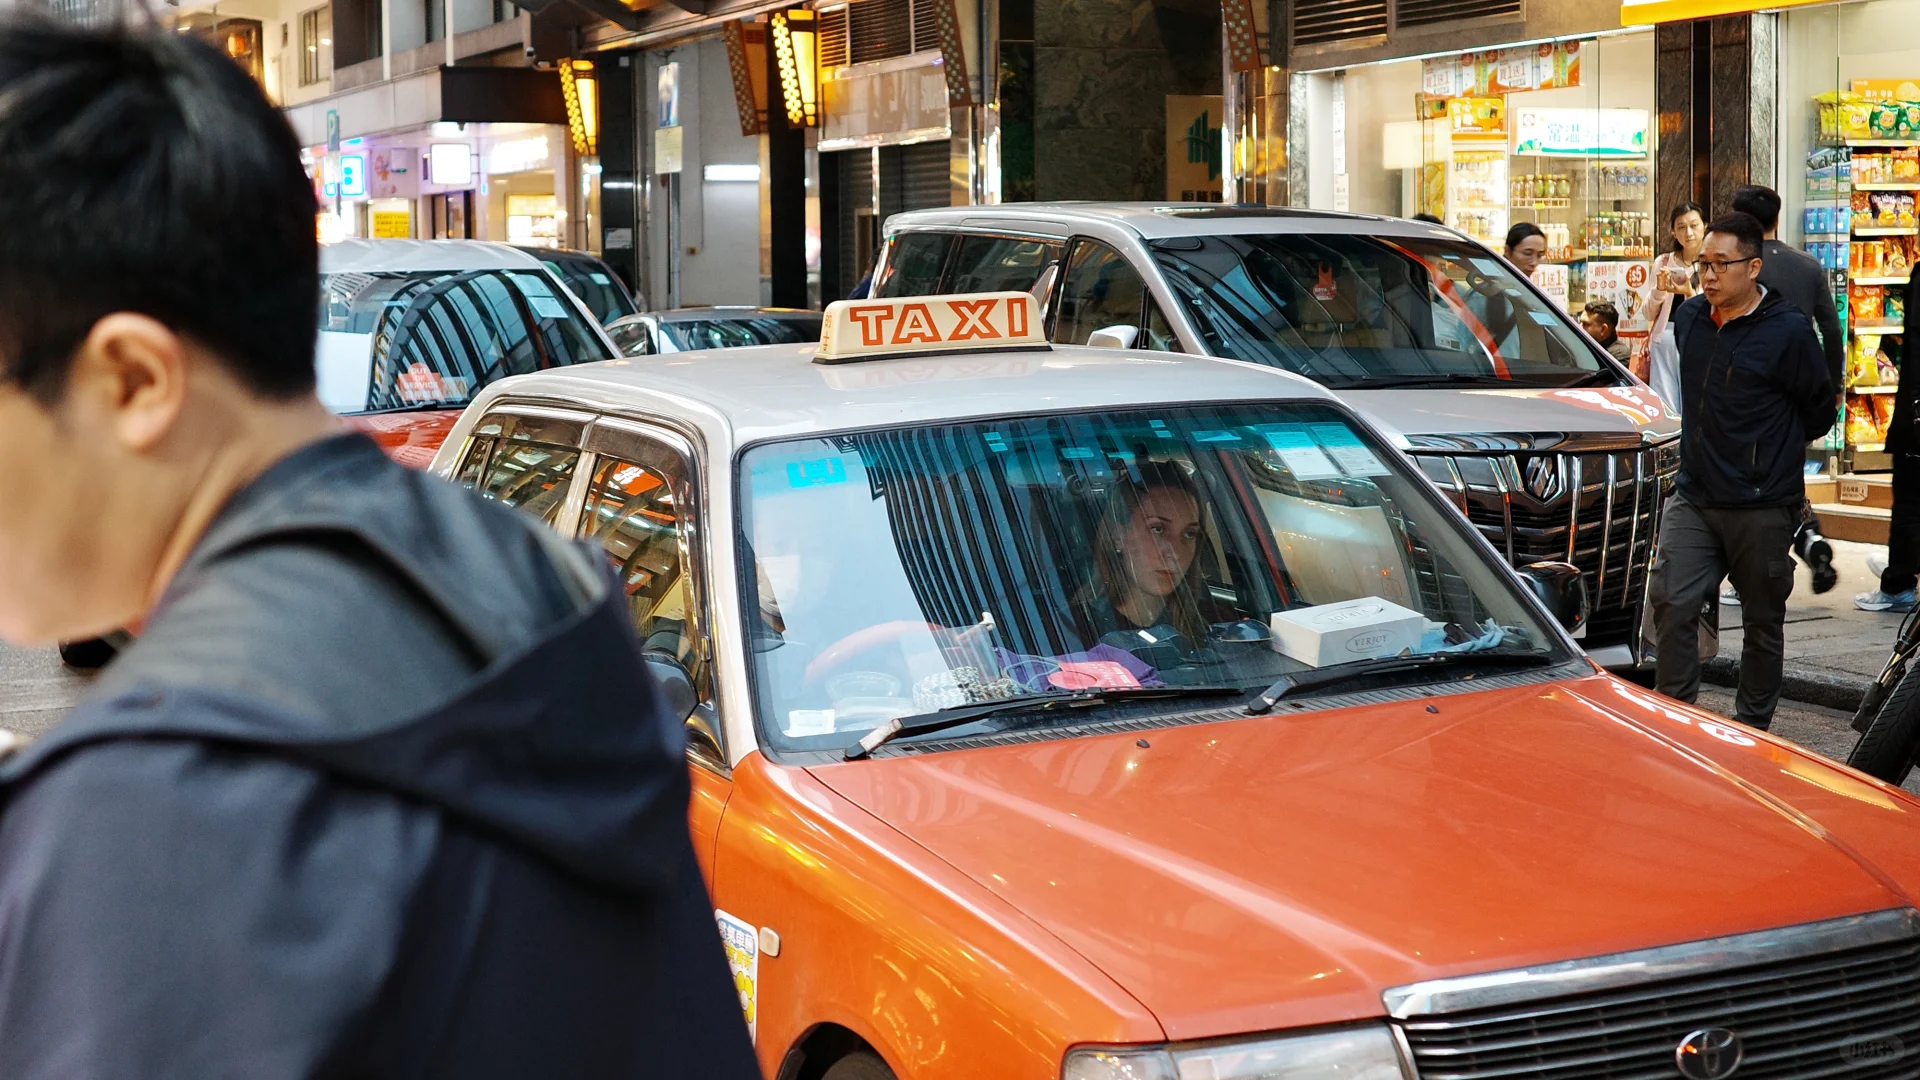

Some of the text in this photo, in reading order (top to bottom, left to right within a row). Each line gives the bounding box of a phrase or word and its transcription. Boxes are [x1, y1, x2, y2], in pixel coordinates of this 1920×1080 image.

[1624, 246, 1652, 258] CIRCLE
[850, 298, 1028, 346] TAXI
[1354, 634, 1388, 646] VIRJOY
